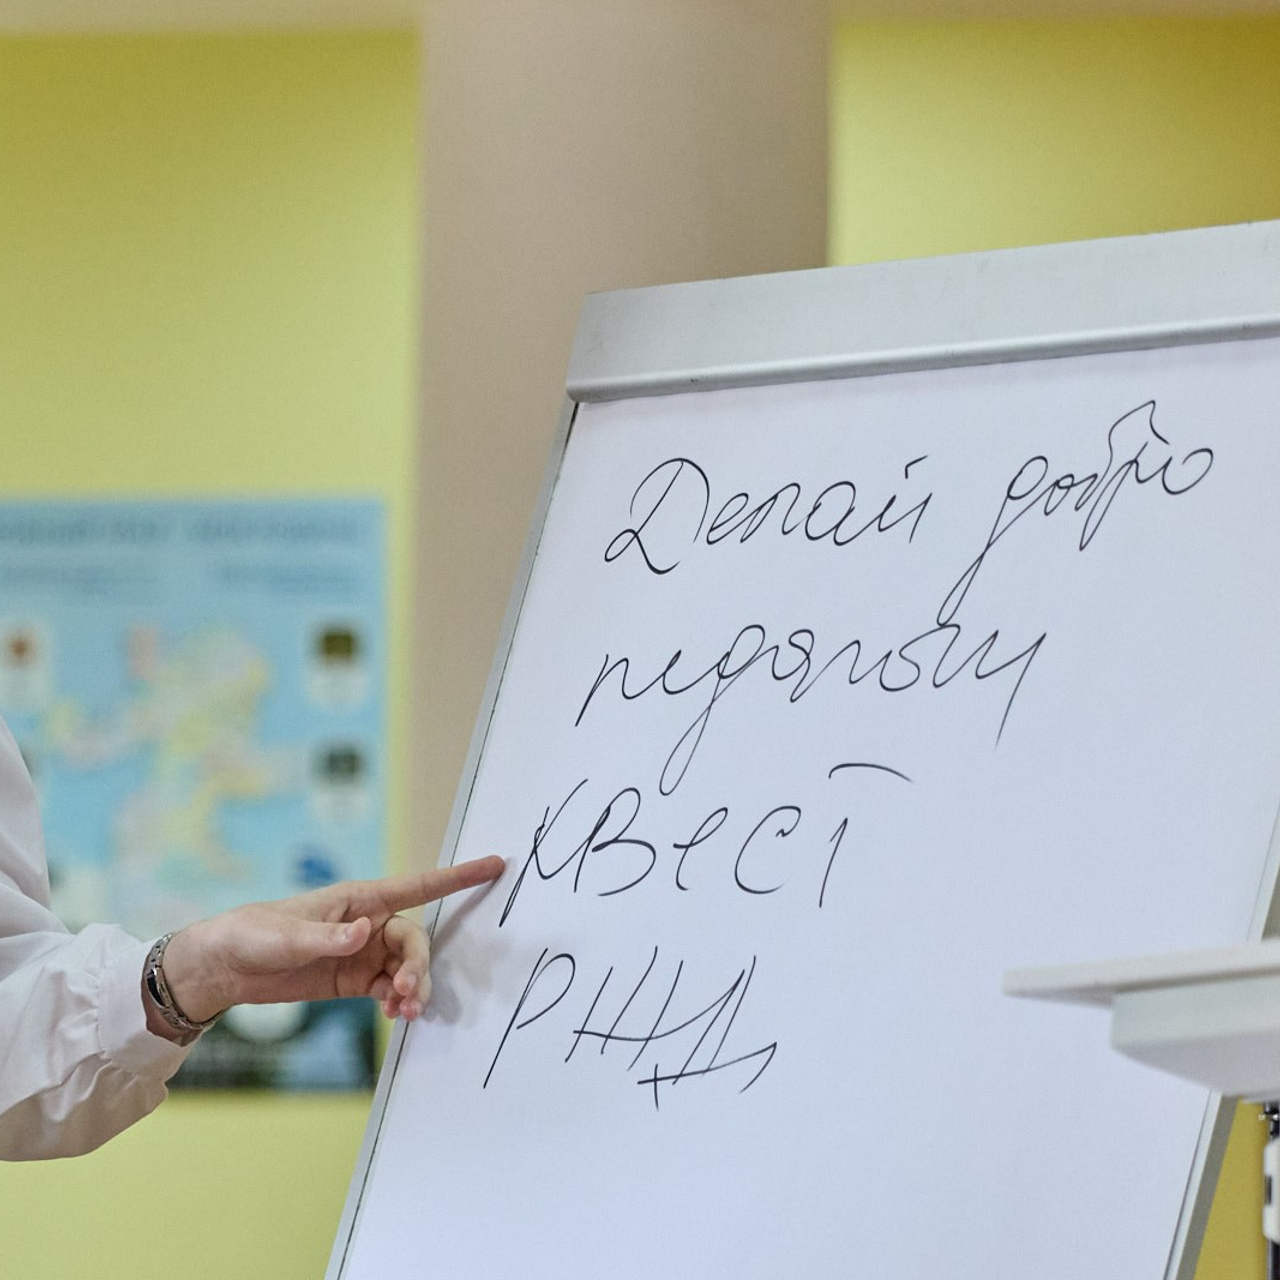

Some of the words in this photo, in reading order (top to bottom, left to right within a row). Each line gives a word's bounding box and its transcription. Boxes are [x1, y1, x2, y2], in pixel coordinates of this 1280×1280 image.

[604, 455, 933, 575] Делай
[936, 400, 1214, 627] добро
[483, 945, 778, 1111] РЖД
